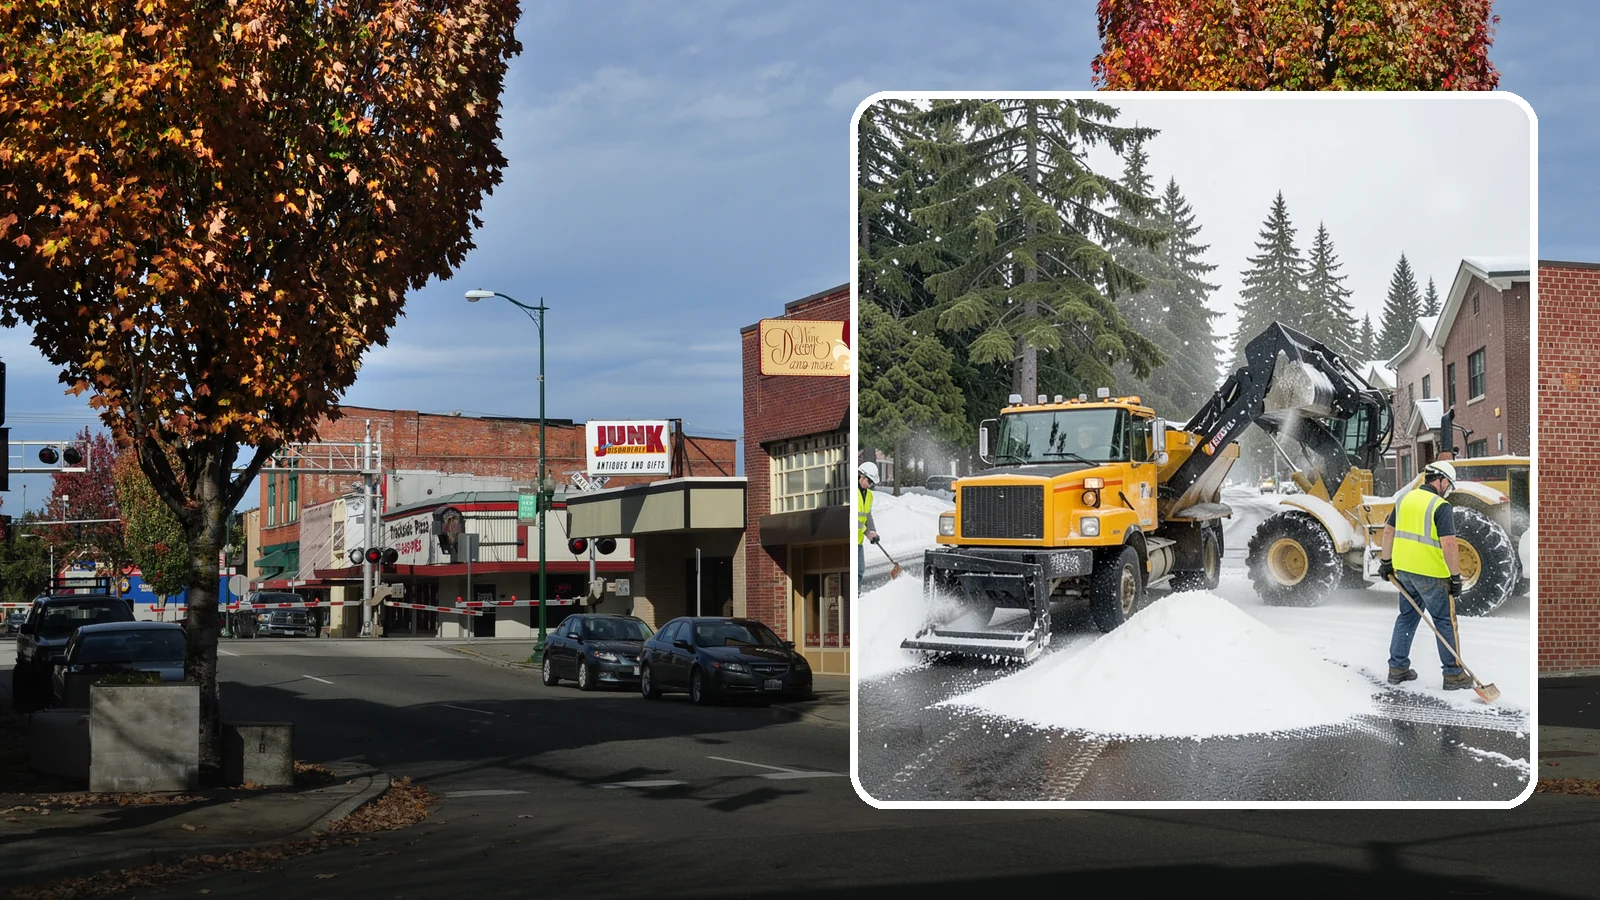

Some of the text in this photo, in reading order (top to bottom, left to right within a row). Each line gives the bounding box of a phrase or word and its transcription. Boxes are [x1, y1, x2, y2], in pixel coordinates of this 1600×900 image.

[595, 425, 666, 457] JUNK
[597, 460, 665, 470] ANTIQUES AND GIFTS
[390, 519, 429, 540] Trackside Pizza
